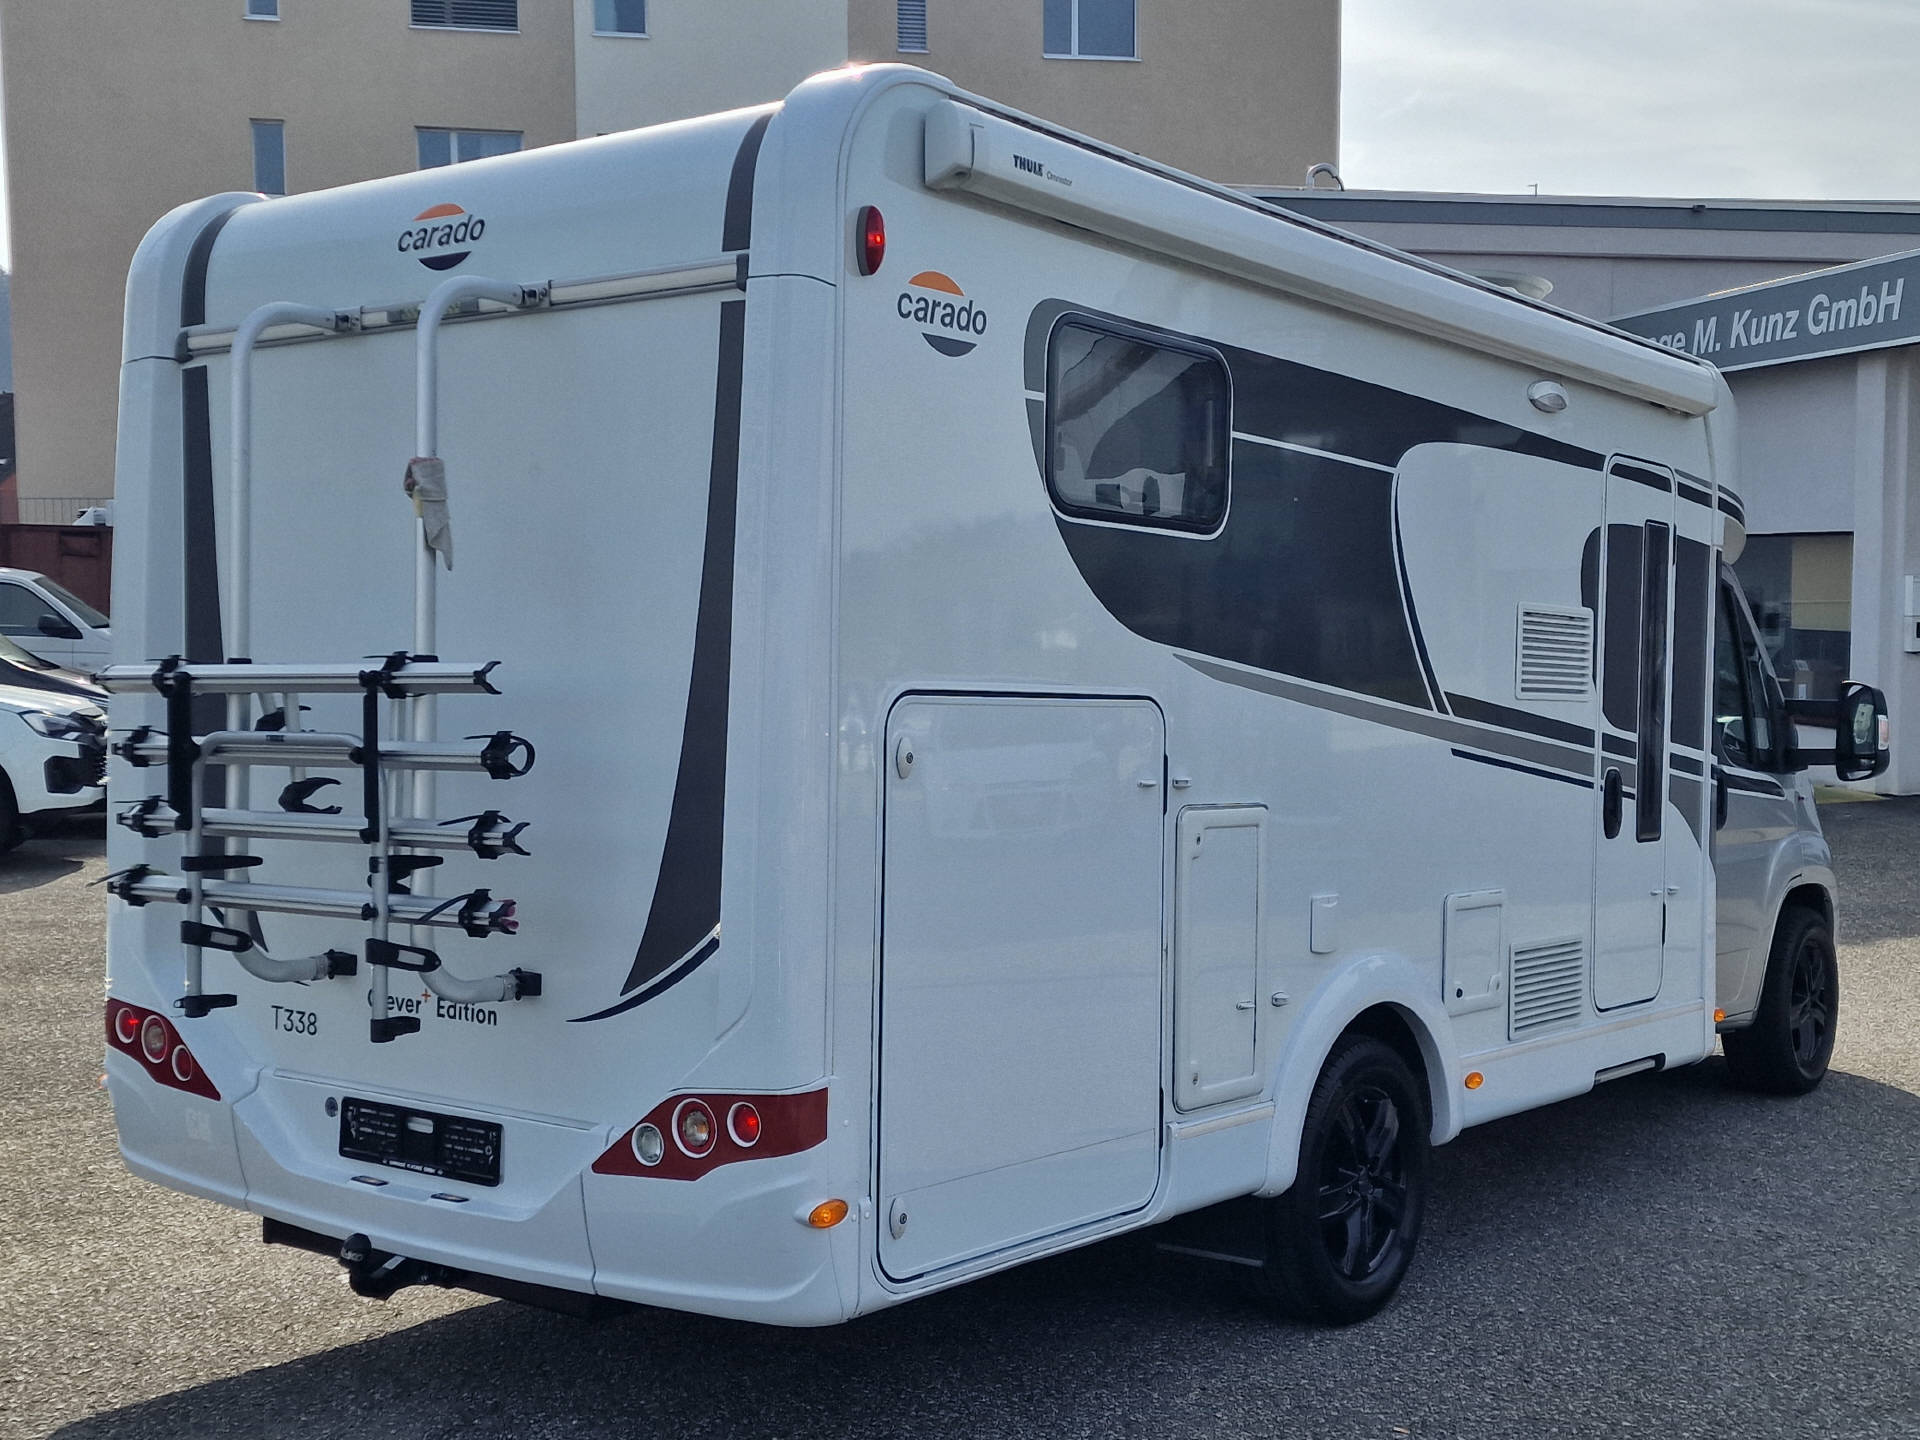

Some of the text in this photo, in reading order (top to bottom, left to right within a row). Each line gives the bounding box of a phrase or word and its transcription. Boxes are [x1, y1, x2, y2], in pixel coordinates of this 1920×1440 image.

[1013, 154, 1044, 177] THULE
[398, 214, 485, 252] carado
[897, 293, 987, 335] carado
[1692, 316, 1721, 356] M.
[1730, 309, 1800, 349] Kunz
[1807, 278, 1905, 336] GmbH
[271, 1005, 318, 1036] T338
[436, 996, 498, 1026] Edition
